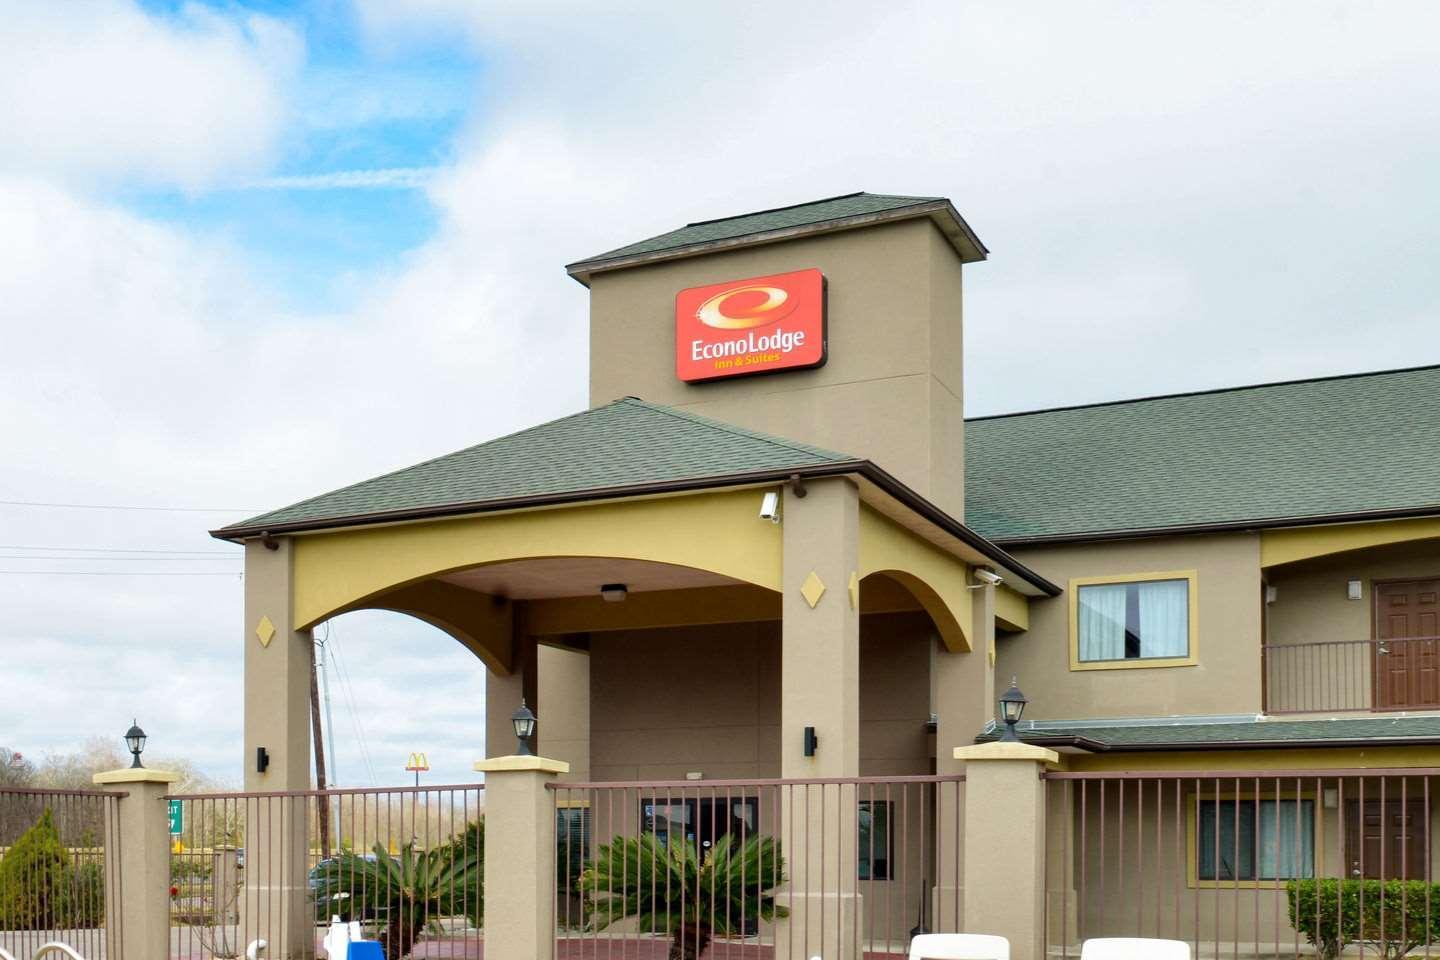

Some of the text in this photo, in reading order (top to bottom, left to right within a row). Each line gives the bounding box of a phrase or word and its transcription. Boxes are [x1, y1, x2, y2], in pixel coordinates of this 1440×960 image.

[691, 329, 805, 361] EconoLodge
[715, 352, 781, 369] Inn & Suites
